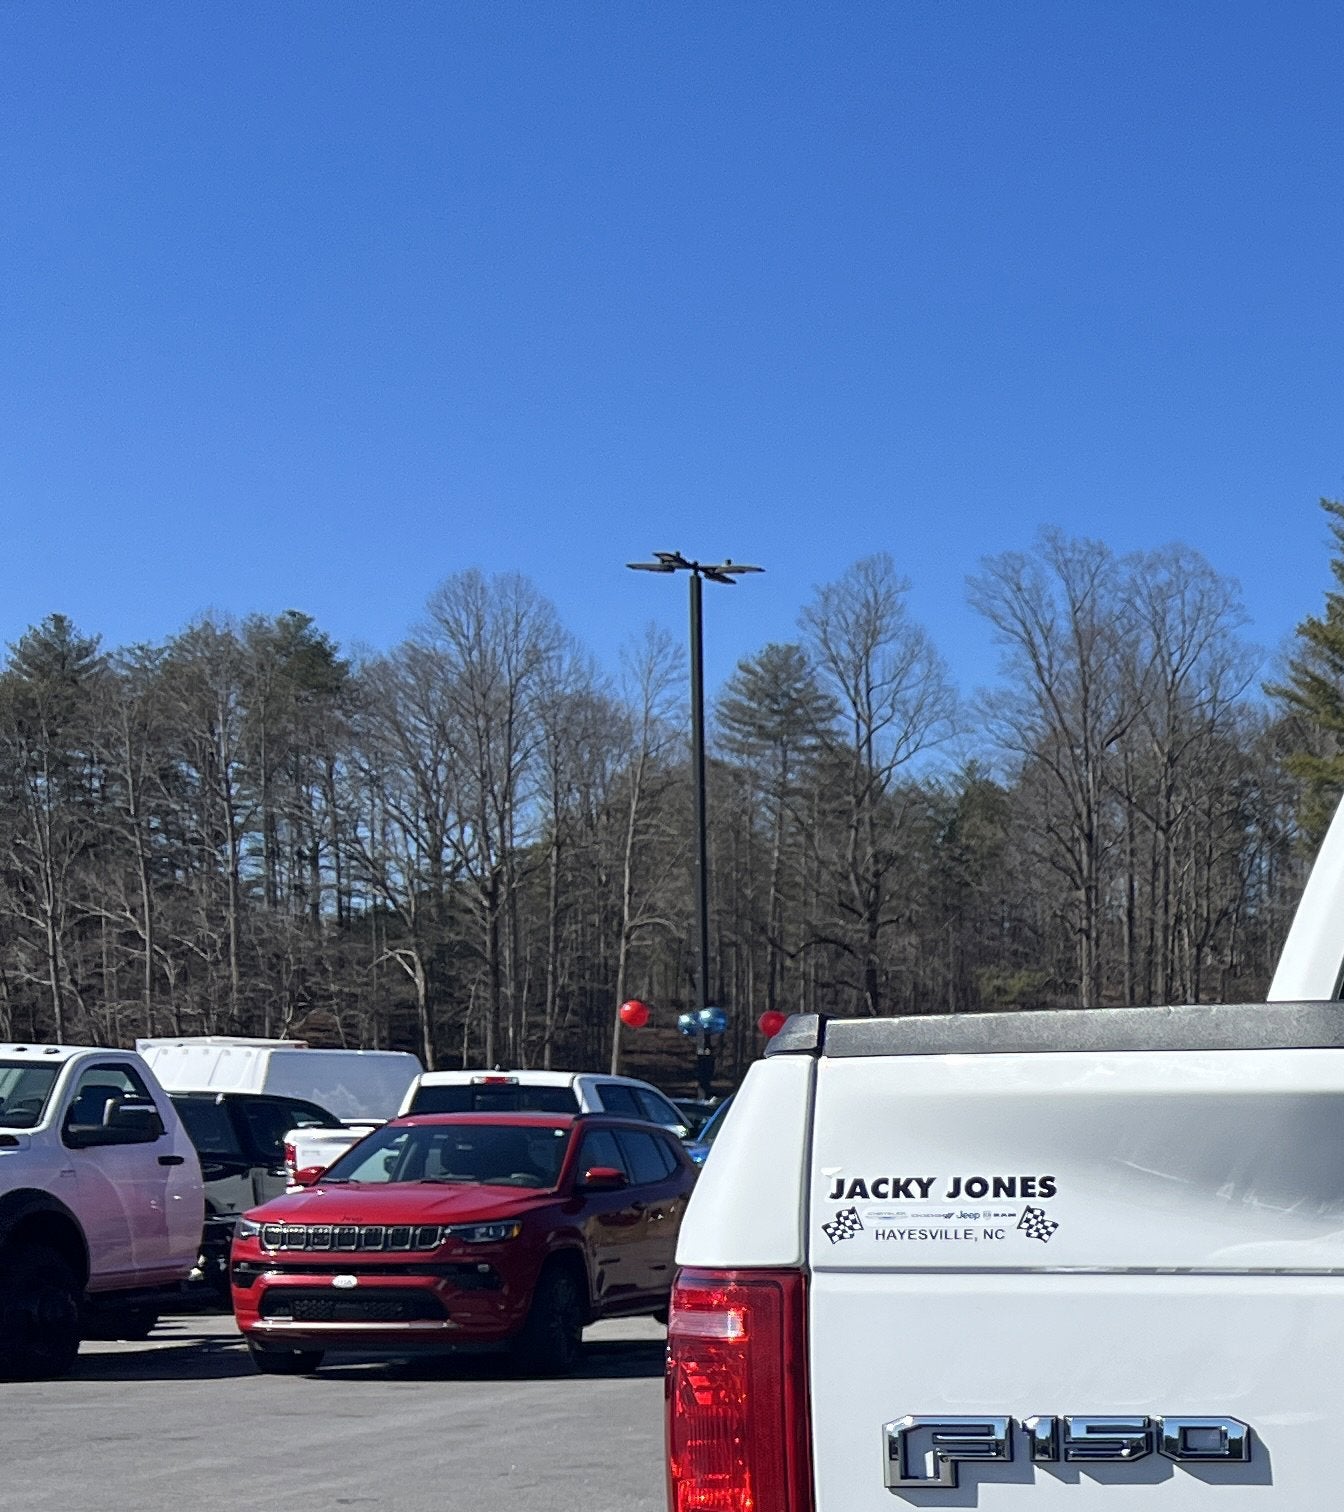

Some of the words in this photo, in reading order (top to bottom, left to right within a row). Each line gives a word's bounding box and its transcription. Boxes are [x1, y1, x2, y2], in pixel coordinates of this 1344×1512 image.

[829, 1176, 936, 1200] JACKY
[946, 1175, 1058, 1199] JONES
[957, 1210, 981, 1221] Jeep
[875, 1229, 978, 1242] HAYESVILLE,
[983, 1228, 1006, 1240] NC
